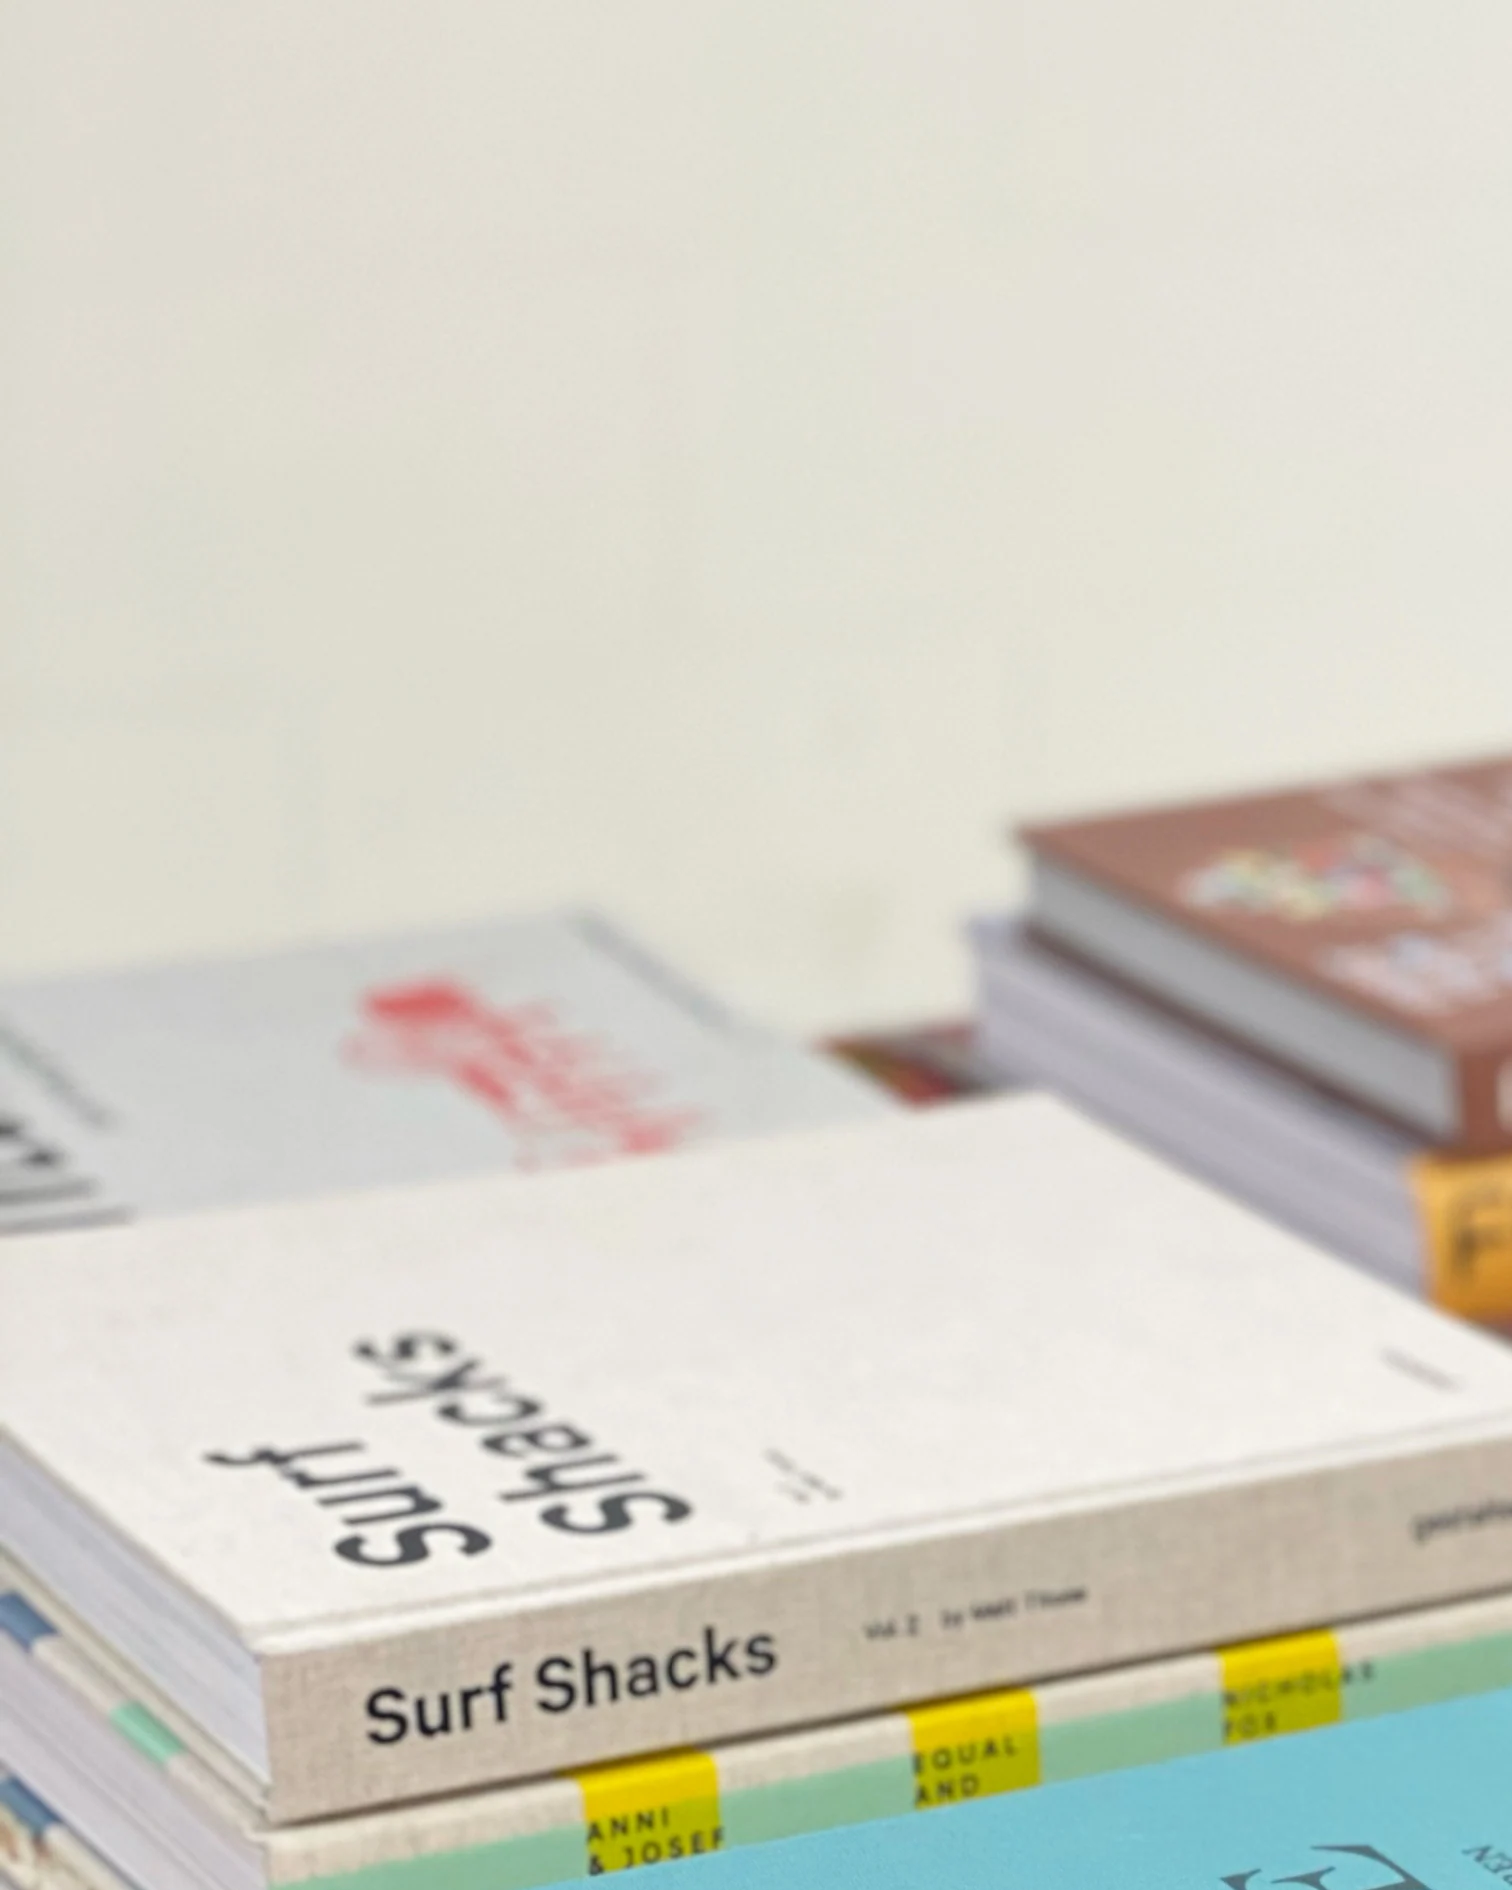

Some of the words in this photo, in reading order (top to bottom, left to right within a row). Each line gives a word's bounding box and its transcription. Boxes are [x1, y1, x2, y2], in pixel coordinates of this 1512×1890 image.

[352, 1328, 694, 1536] Shacks
[202, 1438, 494, 1568] Surf
[365, 1660, 514, 1746] Surf
[535, 1624, 779, 1715] Shacks
[912, 1734, 1019, 1778] EQUAL
[914, 1773, 980, 1808] AND
[586, 1806, 671, 1846] ANNI
[622, 1825, 726, 1870] JOSEF
